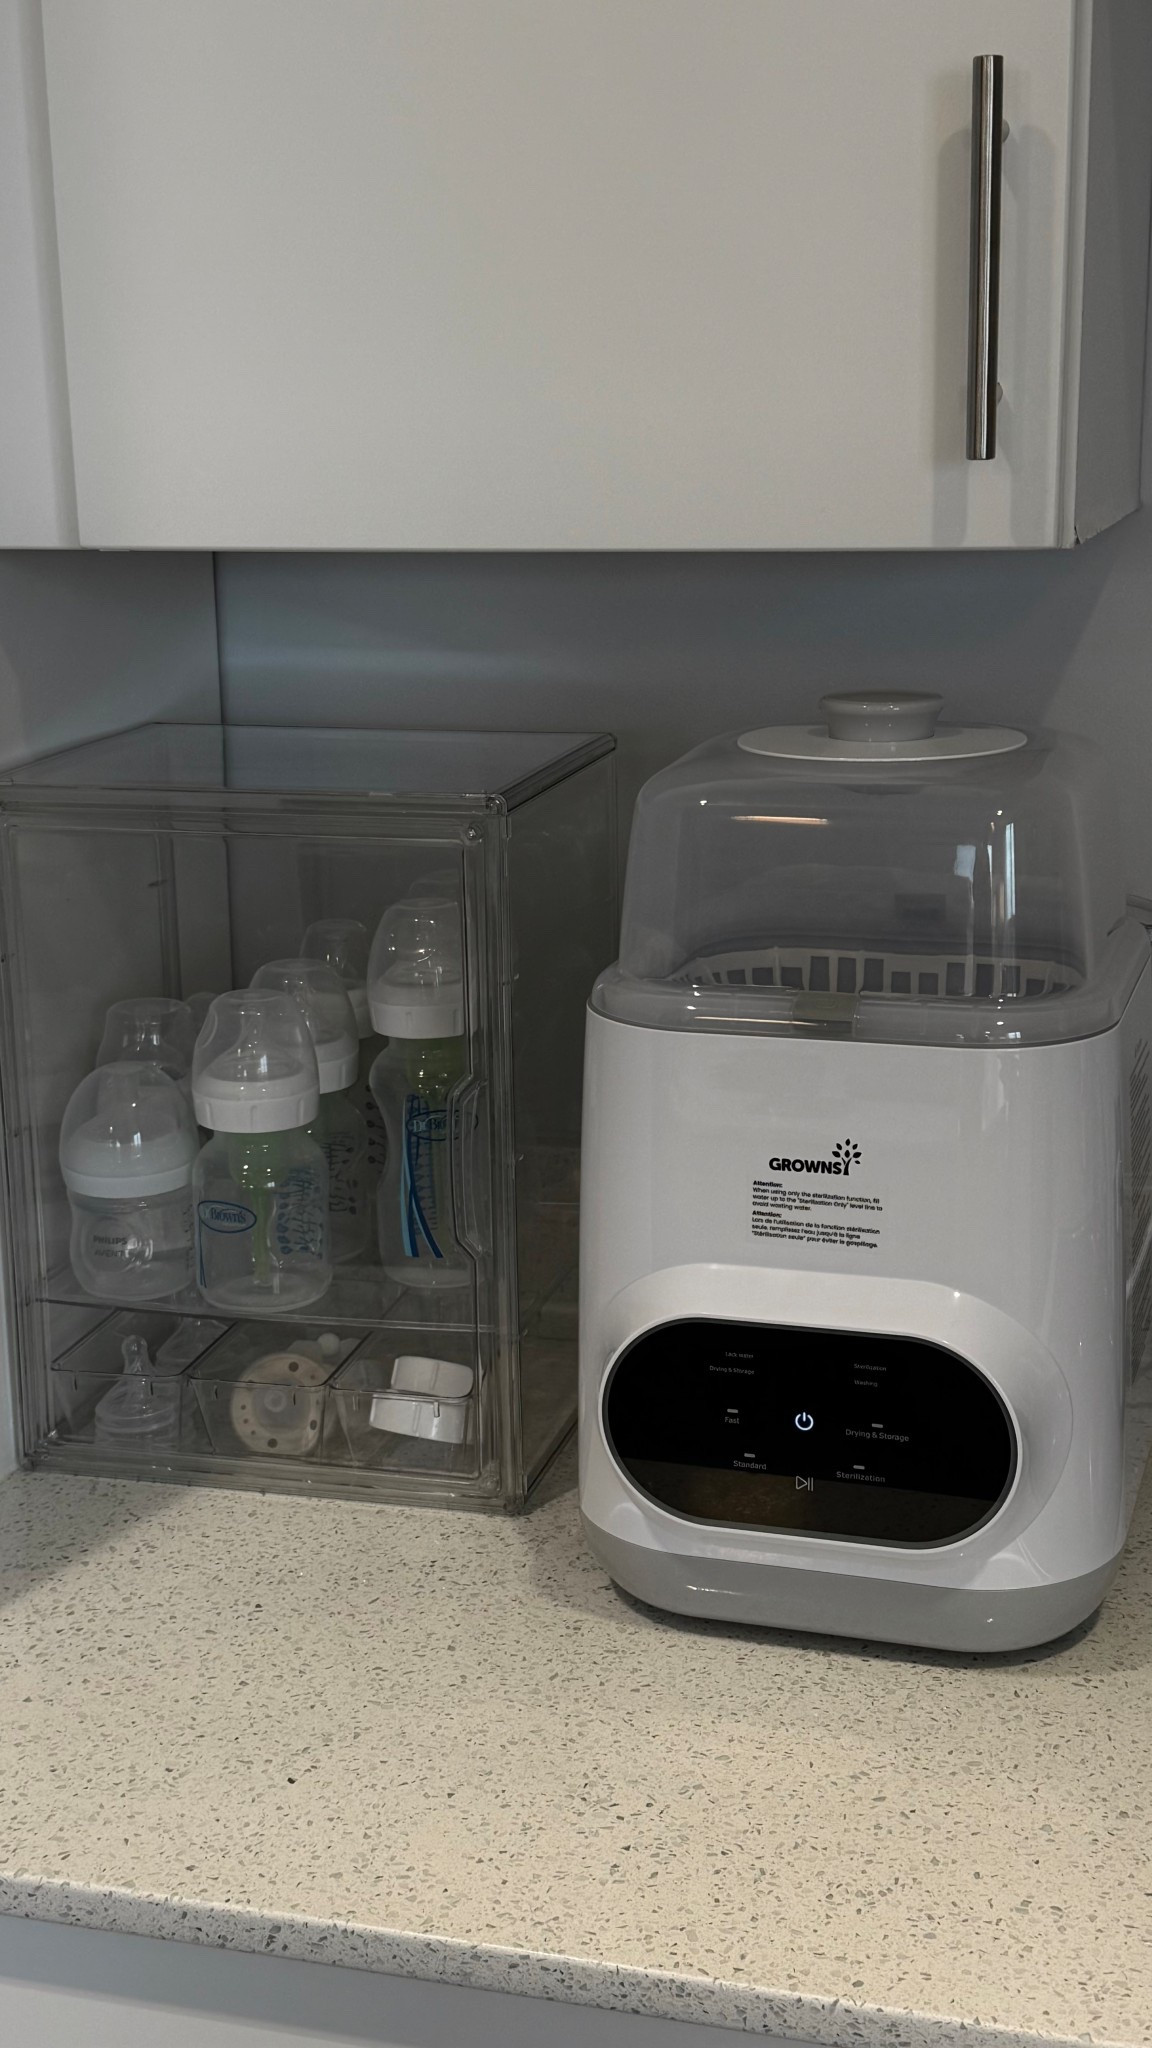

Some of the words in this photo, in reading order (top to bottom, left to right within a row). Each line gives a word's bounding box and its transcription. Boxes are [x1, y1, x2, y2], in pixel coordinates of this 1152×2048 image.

[753, 1180, 783, 1188] Attention:
[812, 1193, 845, 1201] sterilization
[846, 1195, 872, 1203] function,
[752, 1210, 782, 1218] Attention:
[770, 1226, 800, 1234] remplissez
[93, 1235, 127, 1245] PHILIPS
[846, 1429, 870, 1439] Drying
[879, 1432, 909, 1442] Storage
[733, 1460, 767, 1470] Standard
[836, 1471, 886, 1483] Sterilization
